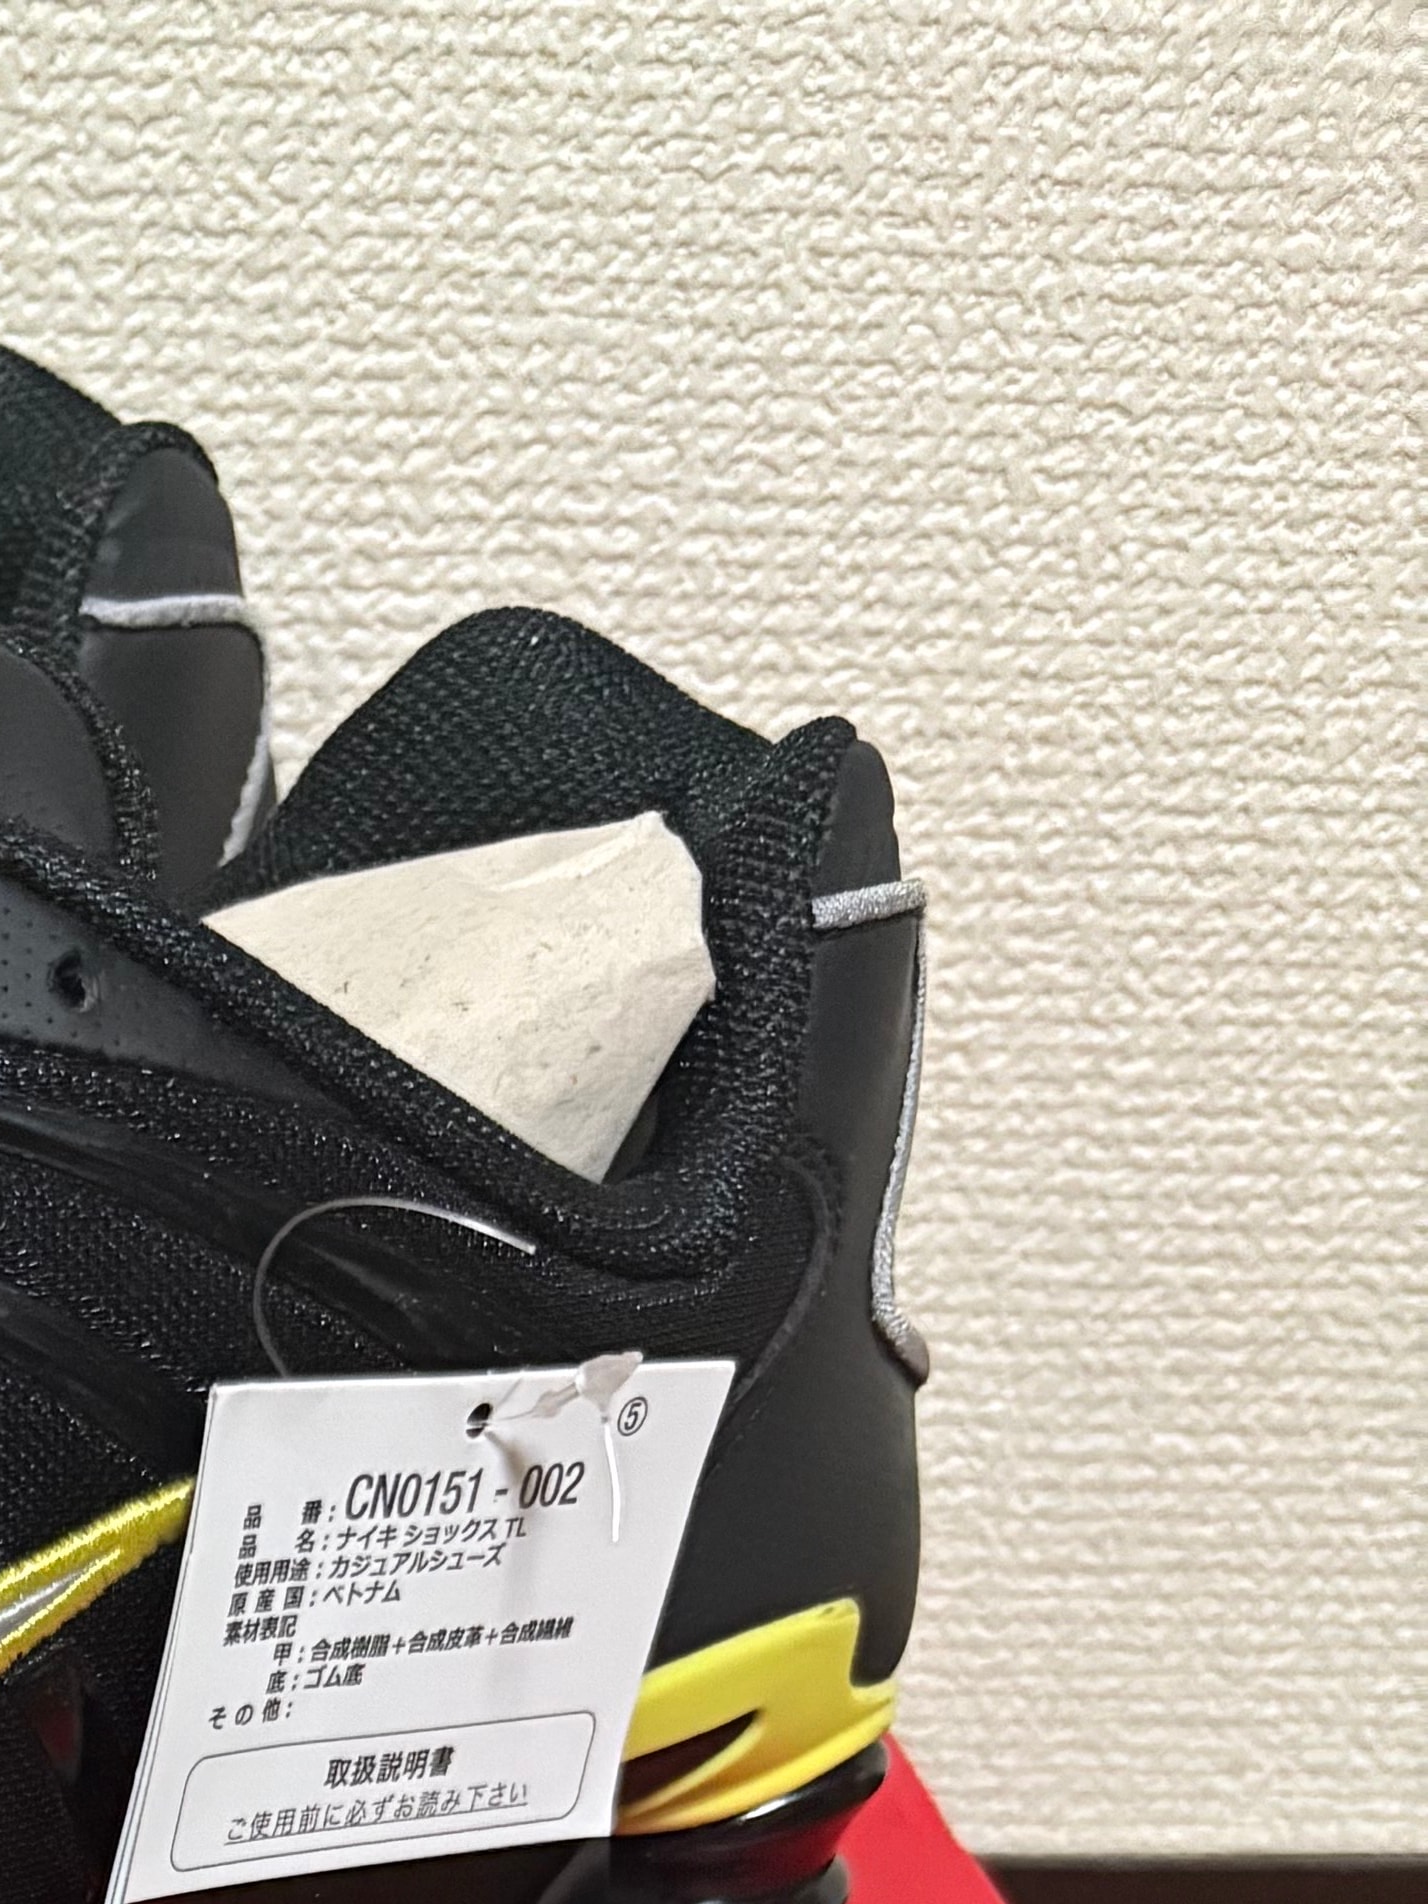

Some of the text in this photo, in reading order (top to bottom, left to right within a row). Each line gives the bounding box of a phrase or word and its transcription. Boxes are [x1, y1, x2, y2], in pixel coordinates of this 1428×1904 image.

[345, 1467, 485, 1521] CN0151
[519, 1461, 586, 1510] 002
[223, 1615, 298, 1647] 素材表記
[323, 1744, 456, 1789] 取扱説明書
[226, 1781, 529, 1842] ご使用前に必ずお読み下さい
